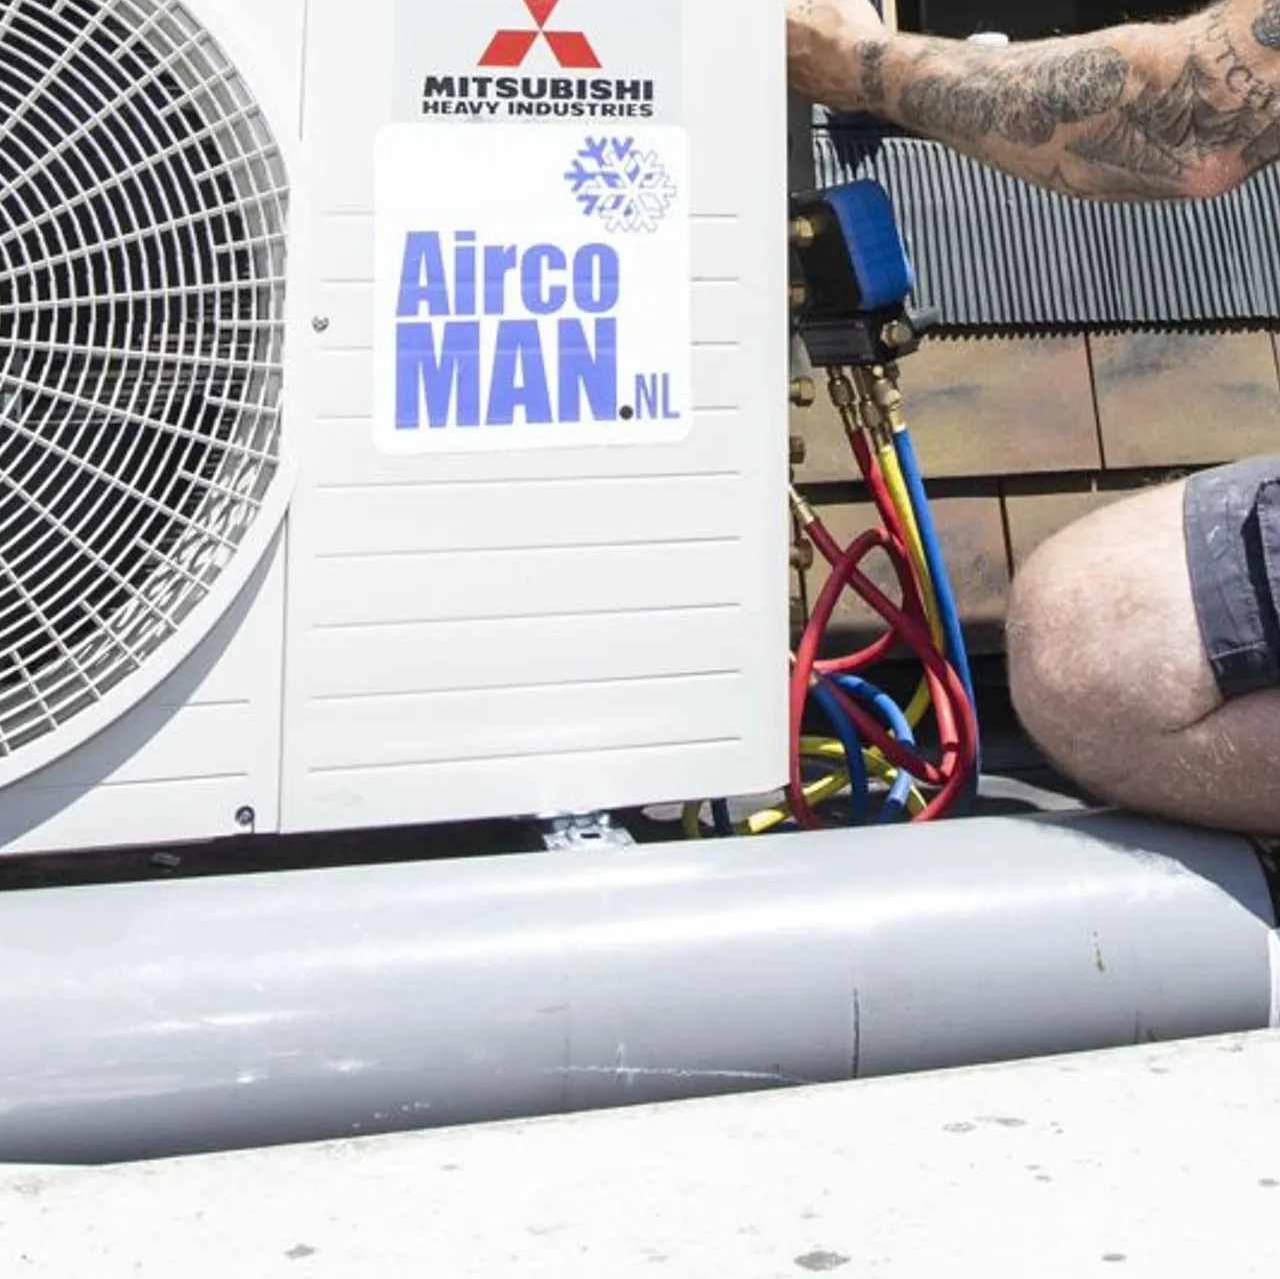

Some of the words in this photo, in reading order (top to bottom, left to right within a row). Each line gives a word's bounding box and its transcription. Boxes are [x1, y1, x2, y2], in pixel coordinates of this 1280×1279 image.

[423, 75, 653, 101] MITSUBISHI
[422, 100, 500, 116] HEAVY
[508, 100, 653, 117] INDUSTRIES
[395, 230, 620, 318] Airco
